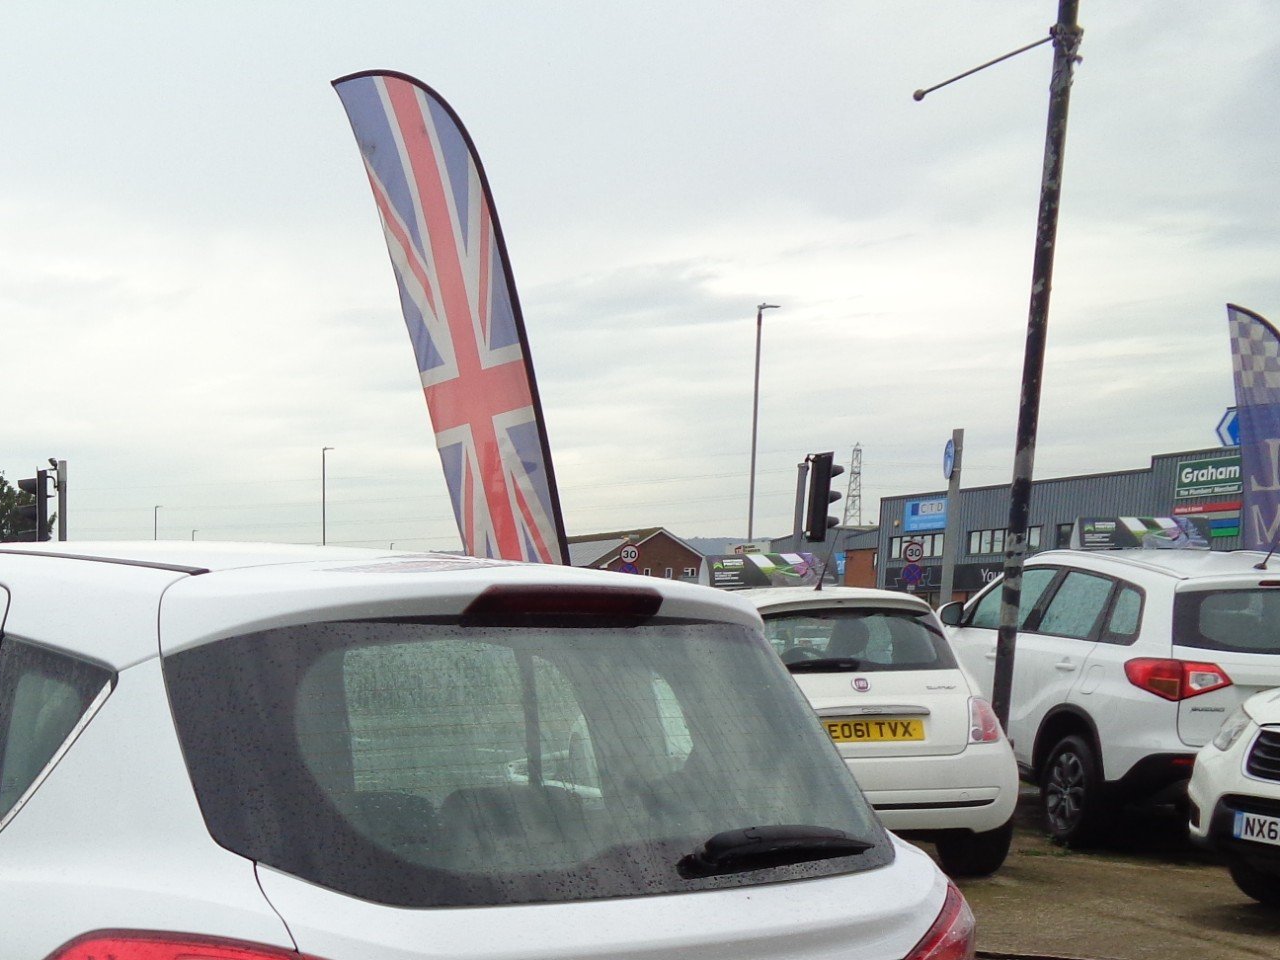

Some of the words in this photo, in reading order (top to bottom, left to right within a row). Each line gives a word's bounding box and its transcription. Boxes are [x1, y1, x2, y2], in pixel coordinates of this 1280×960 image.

[1181, 465, 1240, 483] Graham
[622, 550, 637, 559] 30
[908, 548, 921, 557] 30
[827, 722, 871, 740] EO61
[874, 721, 913, 738] TVX
[1244, 816, 1280, 840] NX6
